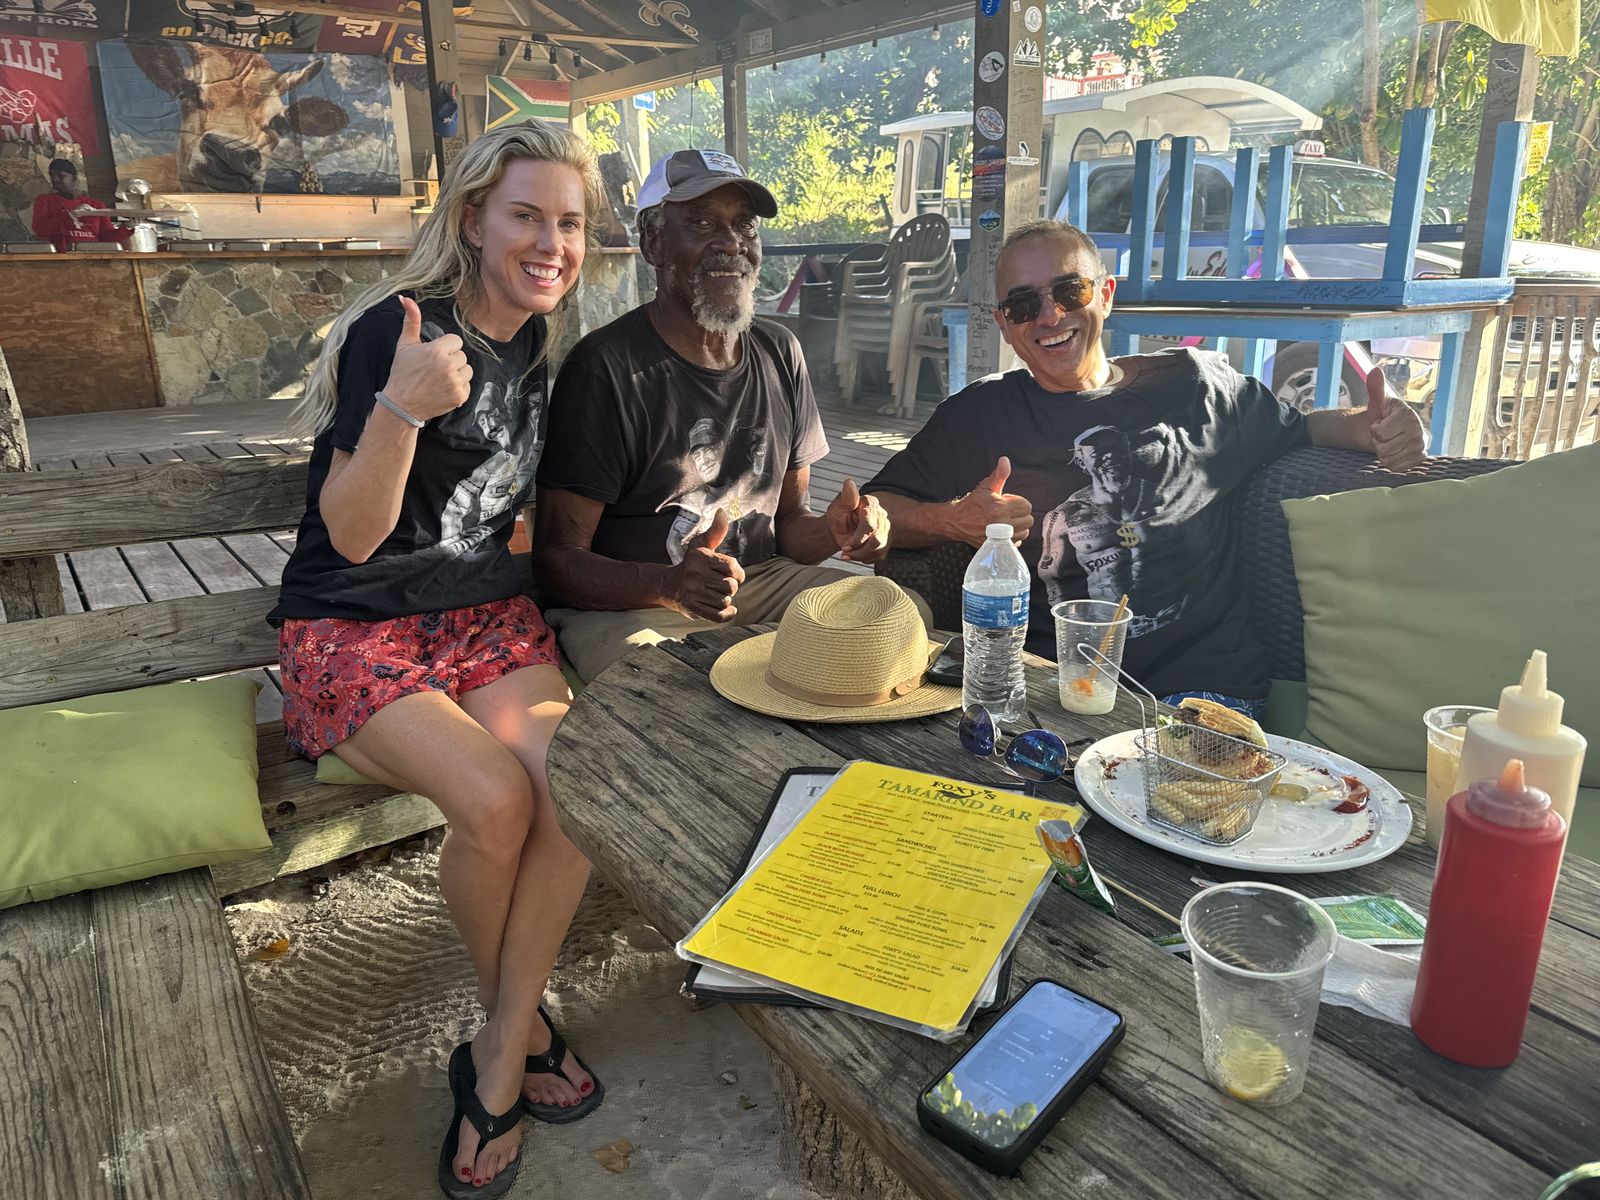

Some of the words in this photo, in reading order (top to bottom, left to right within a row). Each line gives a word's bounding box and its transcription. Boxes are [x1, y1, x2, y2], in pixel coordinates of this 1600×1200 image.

[161, 26, 193, 37] GO
[1303, 142, 1322, 153] TAXI
[879, 779, 984, 810] TAMARIND
[988, 804, 1033, 822] BAR
[922, 811, 953, 820] STARTERS
[895, 837, 938, 850] SANDWICHES
[861, 884, 878, 892] FULL
[877, 888, 901, 898] LUNCH
[837, 925, 865, 936] SALADS
